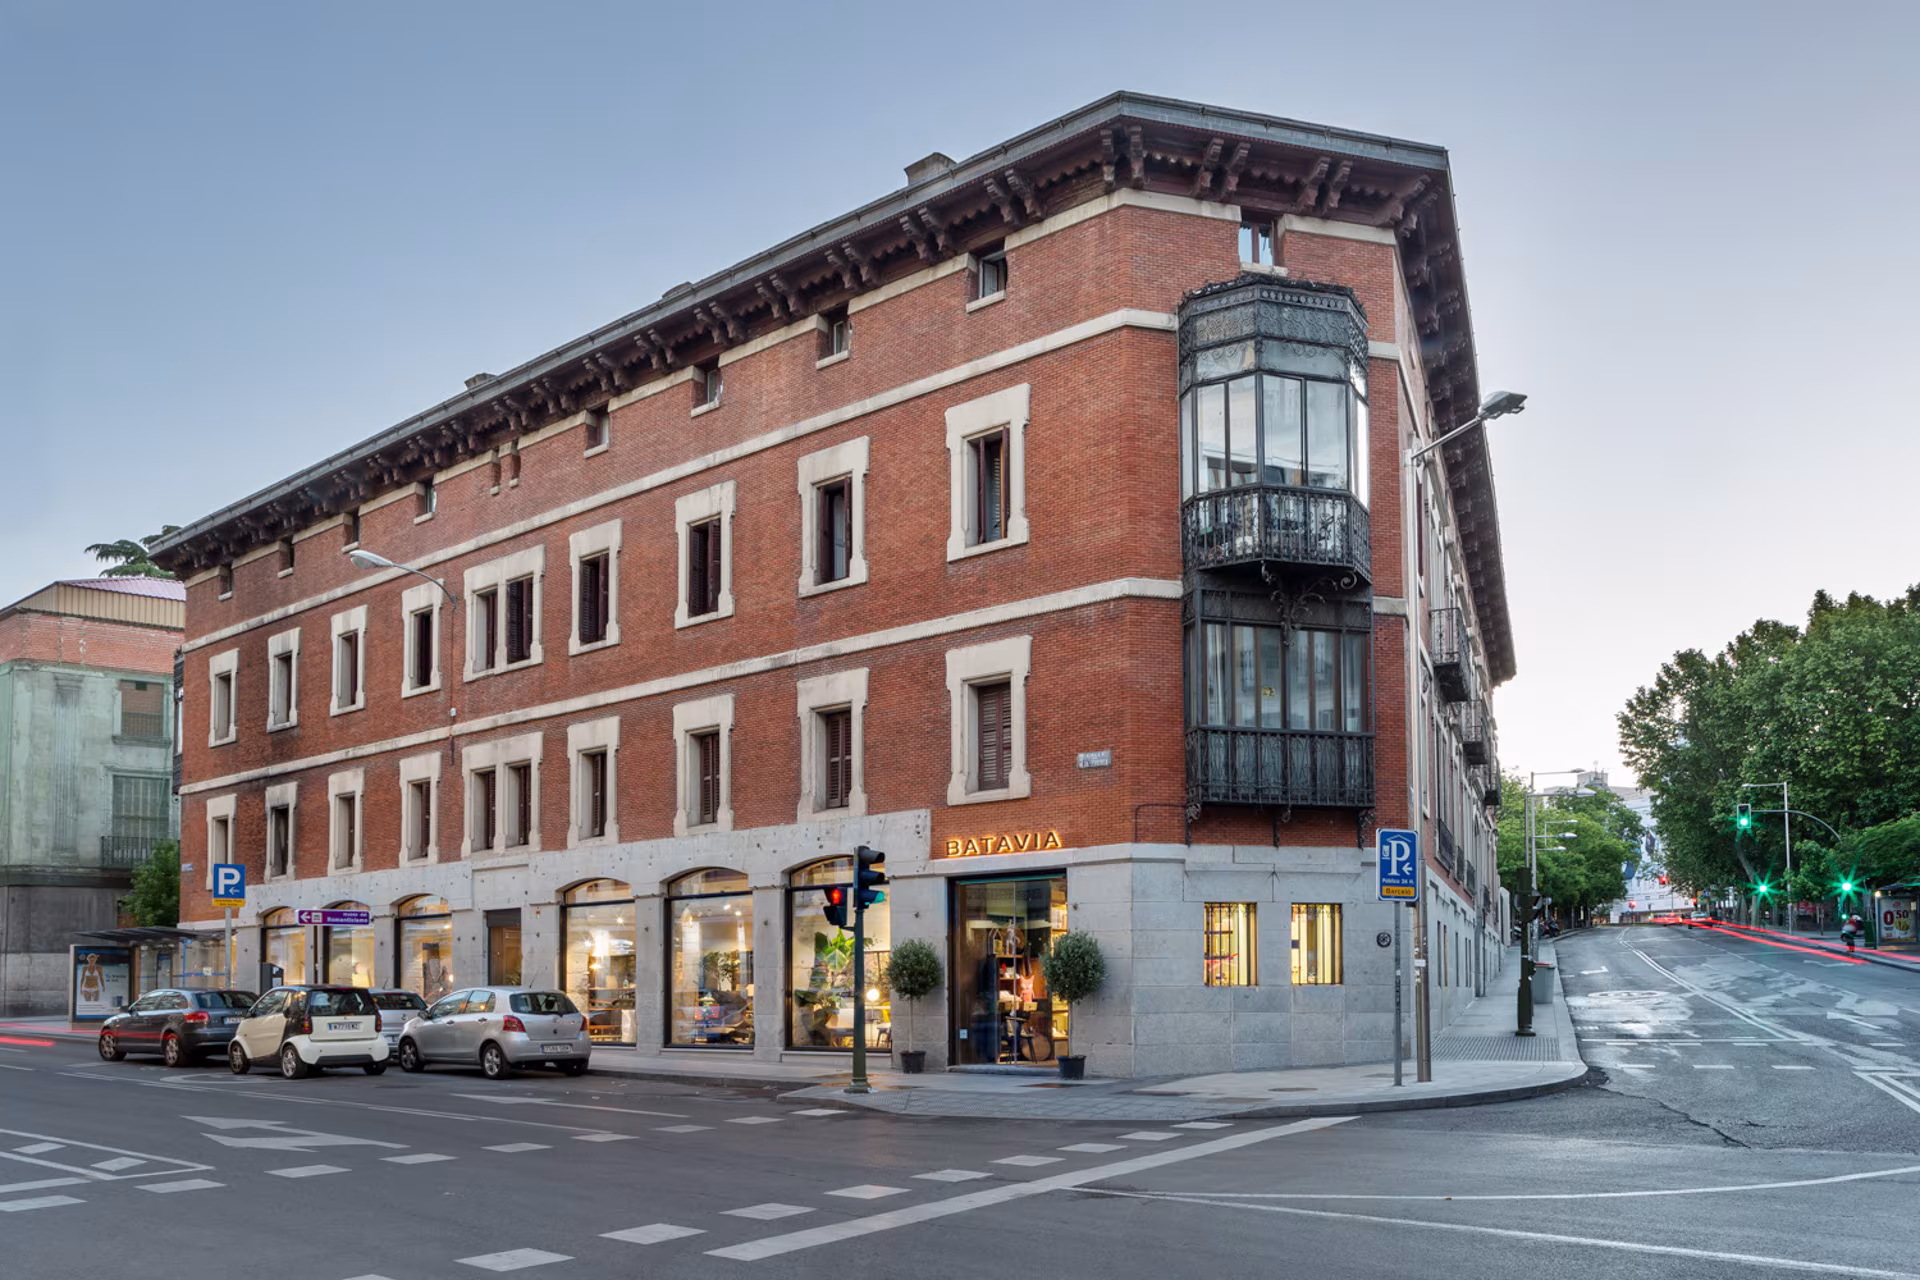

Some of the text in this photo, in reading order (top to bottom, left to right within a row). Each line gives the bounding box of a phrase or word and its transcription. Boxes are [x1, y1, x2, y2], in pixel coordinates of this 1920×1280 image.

[946, 831, 1061, 857] BATAVIA
[1387, 840, 1410, 876] P
[218, 868, 241, 895] P
